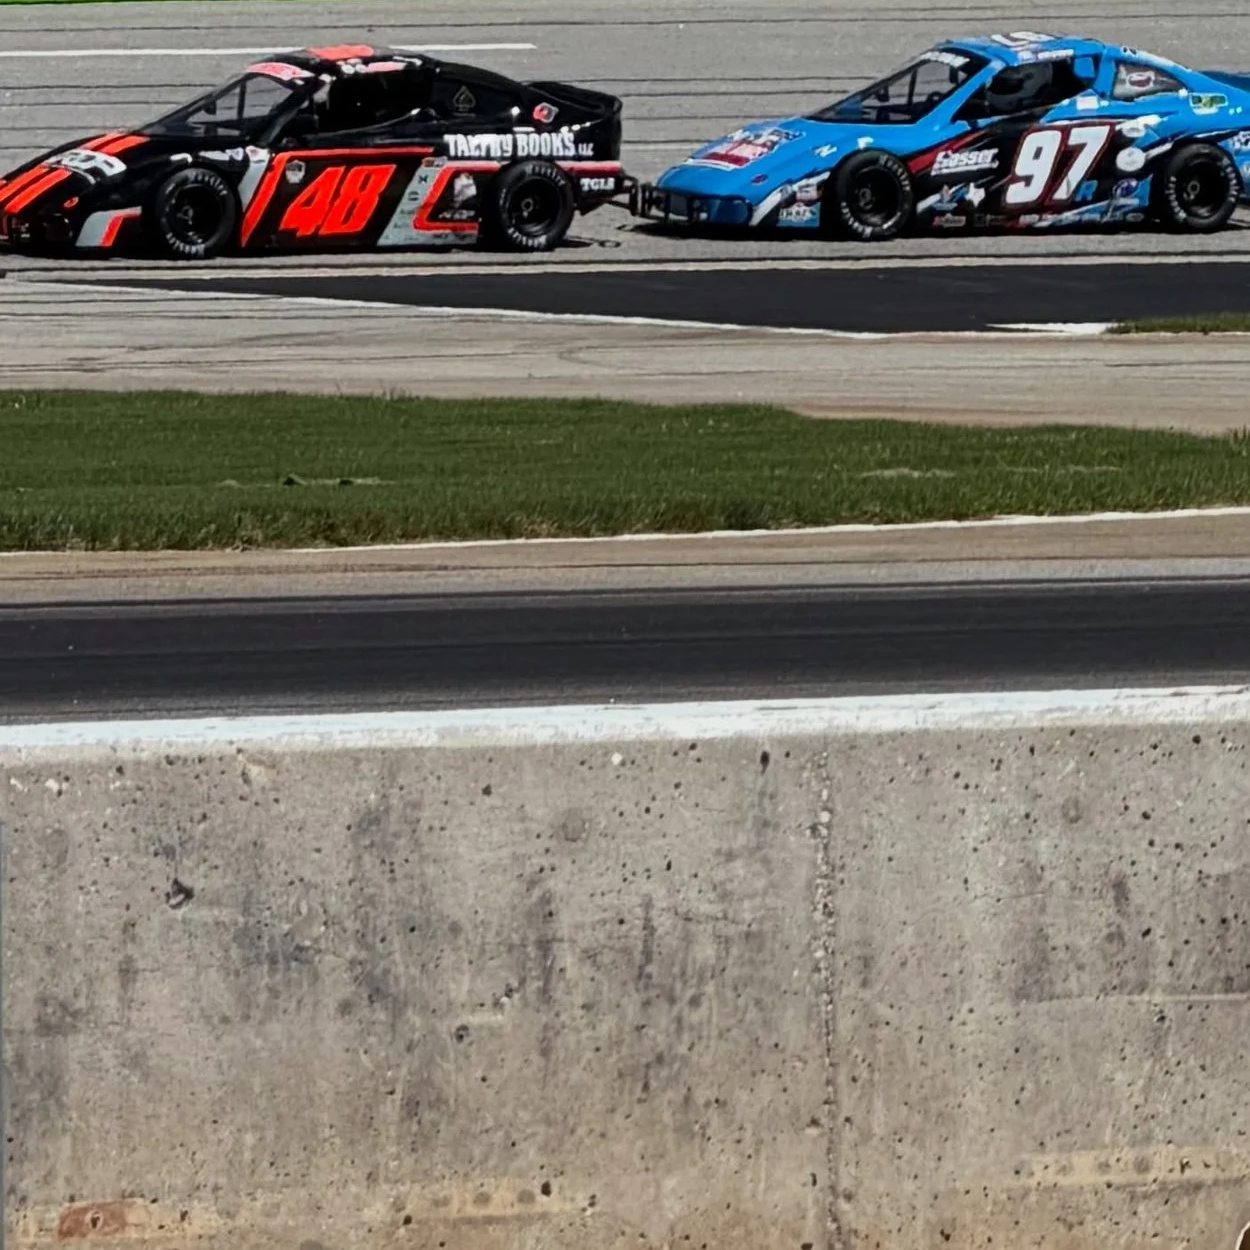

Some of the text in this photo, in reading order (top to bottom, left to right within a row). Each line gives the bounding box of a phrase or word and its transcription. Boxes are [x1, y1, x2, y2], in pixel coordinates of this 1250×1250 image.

[516, 132, 575, 157] BOOKS
[1004, 124, 1111, 204] 97
[279, 165, 397, 238] 48
